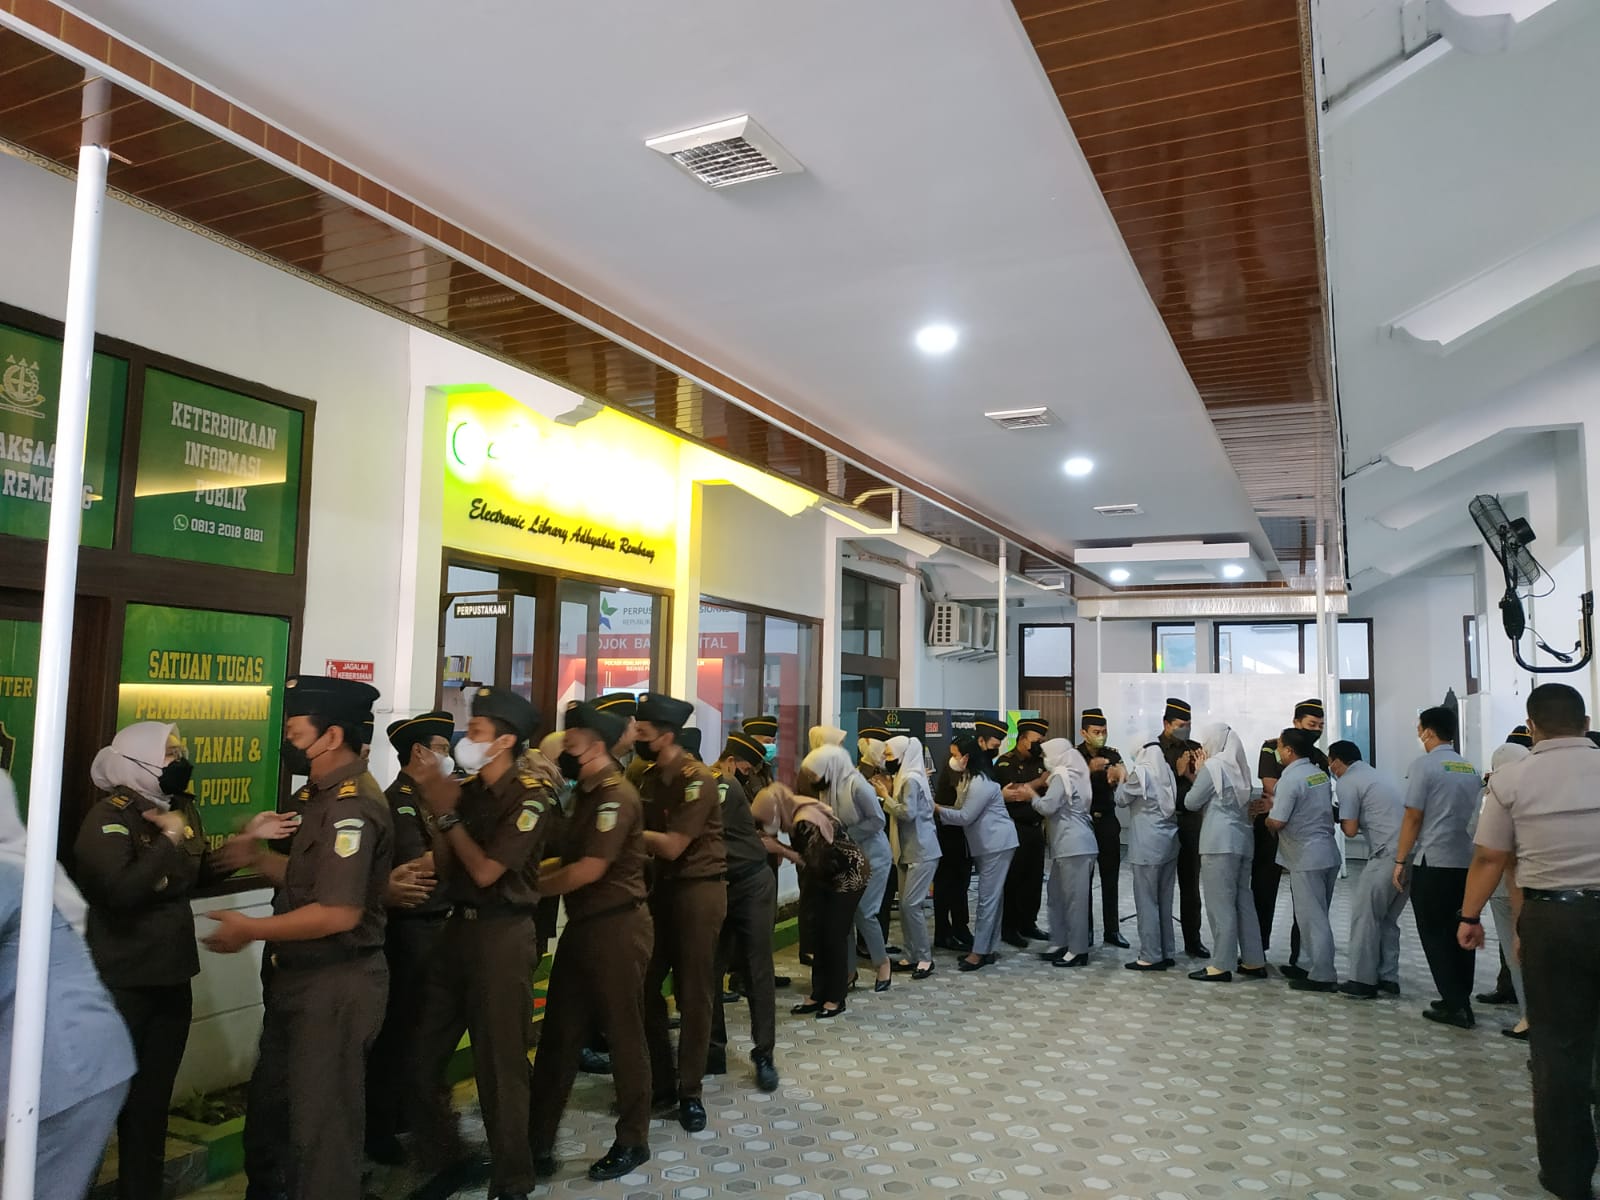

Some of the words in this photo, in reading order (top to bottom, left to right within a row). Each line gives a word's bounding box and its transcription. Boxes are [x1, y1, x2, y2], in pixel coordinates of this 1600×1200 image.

[171, 401, 277, 451] KETERBUKAAN
[0, 431, 56, 469] AKSAA
[184, 441, 261, 479] INFORMASI
[2, 468, 93, 510] REMBG
[195, 480, 248, 511] PUBLIK
[191, 518, 216, 534] 0813
[218, 523, 241, 538] 2018
[243, 527, 264, 542] 8181
[469, 498, 525, 529] Electronic
[528, 515, 568, 544] Library
[570, 526, 615, 551] Adhyaksa
[619, 537, 655, 563] Rembang
[457, 605, 507, 616] PERPUSTAKAAN
[149, 651, 212, 681] SATUAN
[216, 655, 264, 683] TUGAS
[0, 676, 33, 698] TER
[194, 736, 245, 763] TANAH
[248, 737, 262, 762] &
[200, 777, 252, 807] PUPUK
